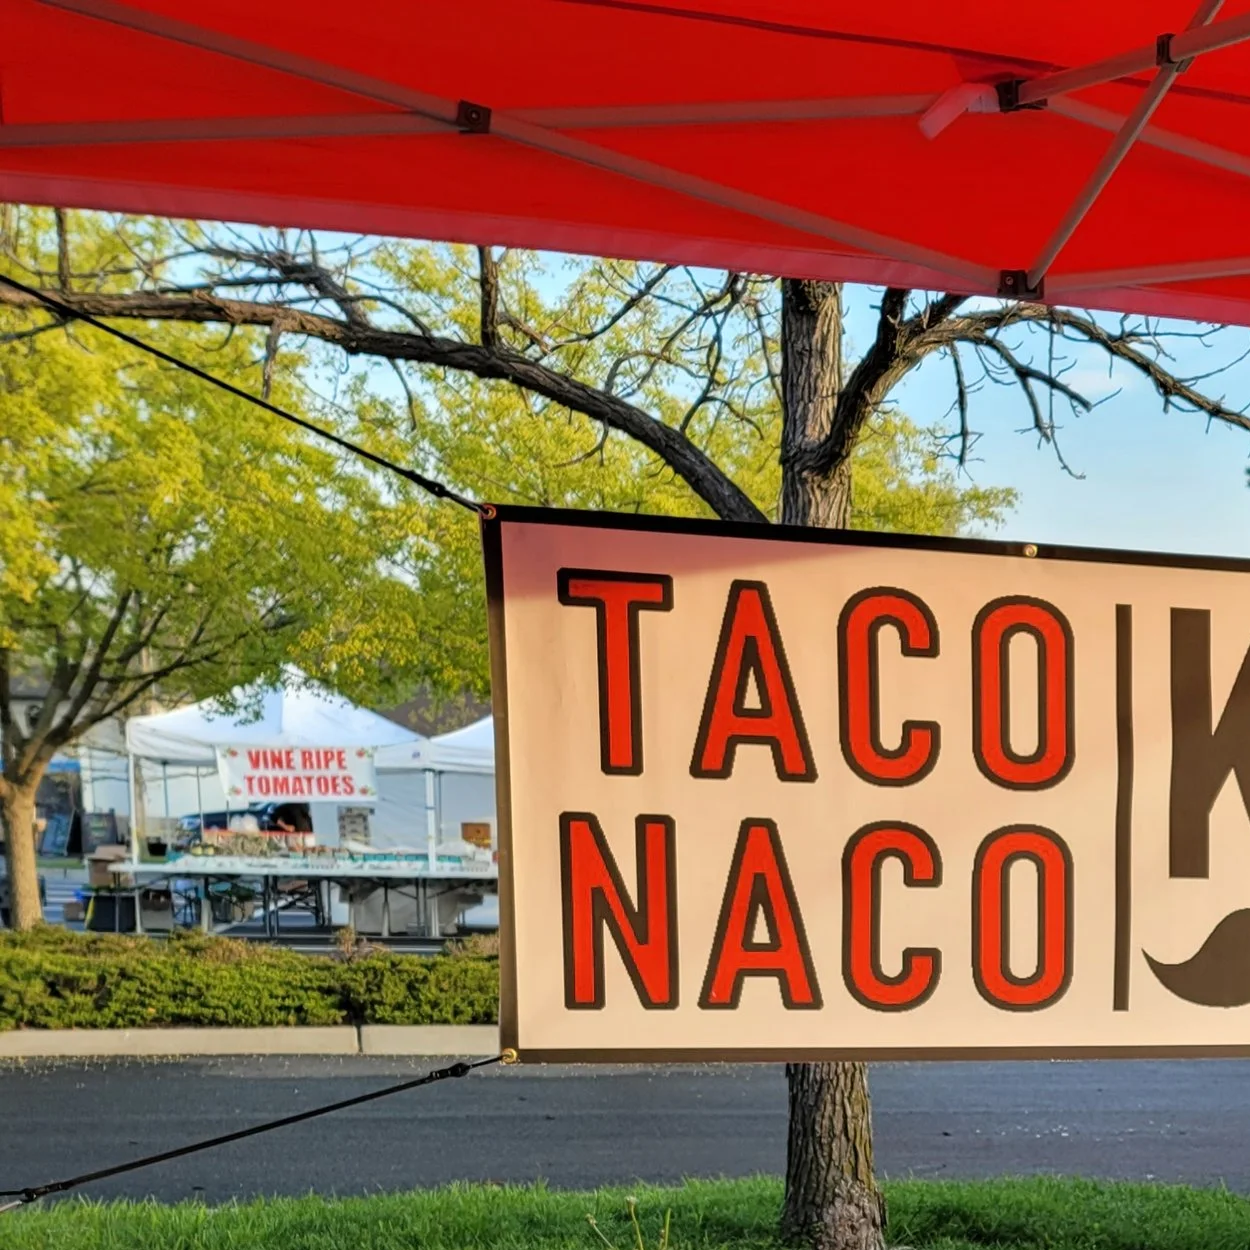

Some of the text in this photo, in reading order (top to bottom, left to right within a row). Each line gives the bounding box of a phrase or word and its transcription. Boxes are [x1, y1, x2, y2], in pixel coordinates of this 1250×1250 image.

[557, 567, 1075, 790] TACO
[244, 775, 355, 796] TOMATOES
[247, 748, 347, 769] VINE RIPE
[558, 811, 1074, 1012] NACO
